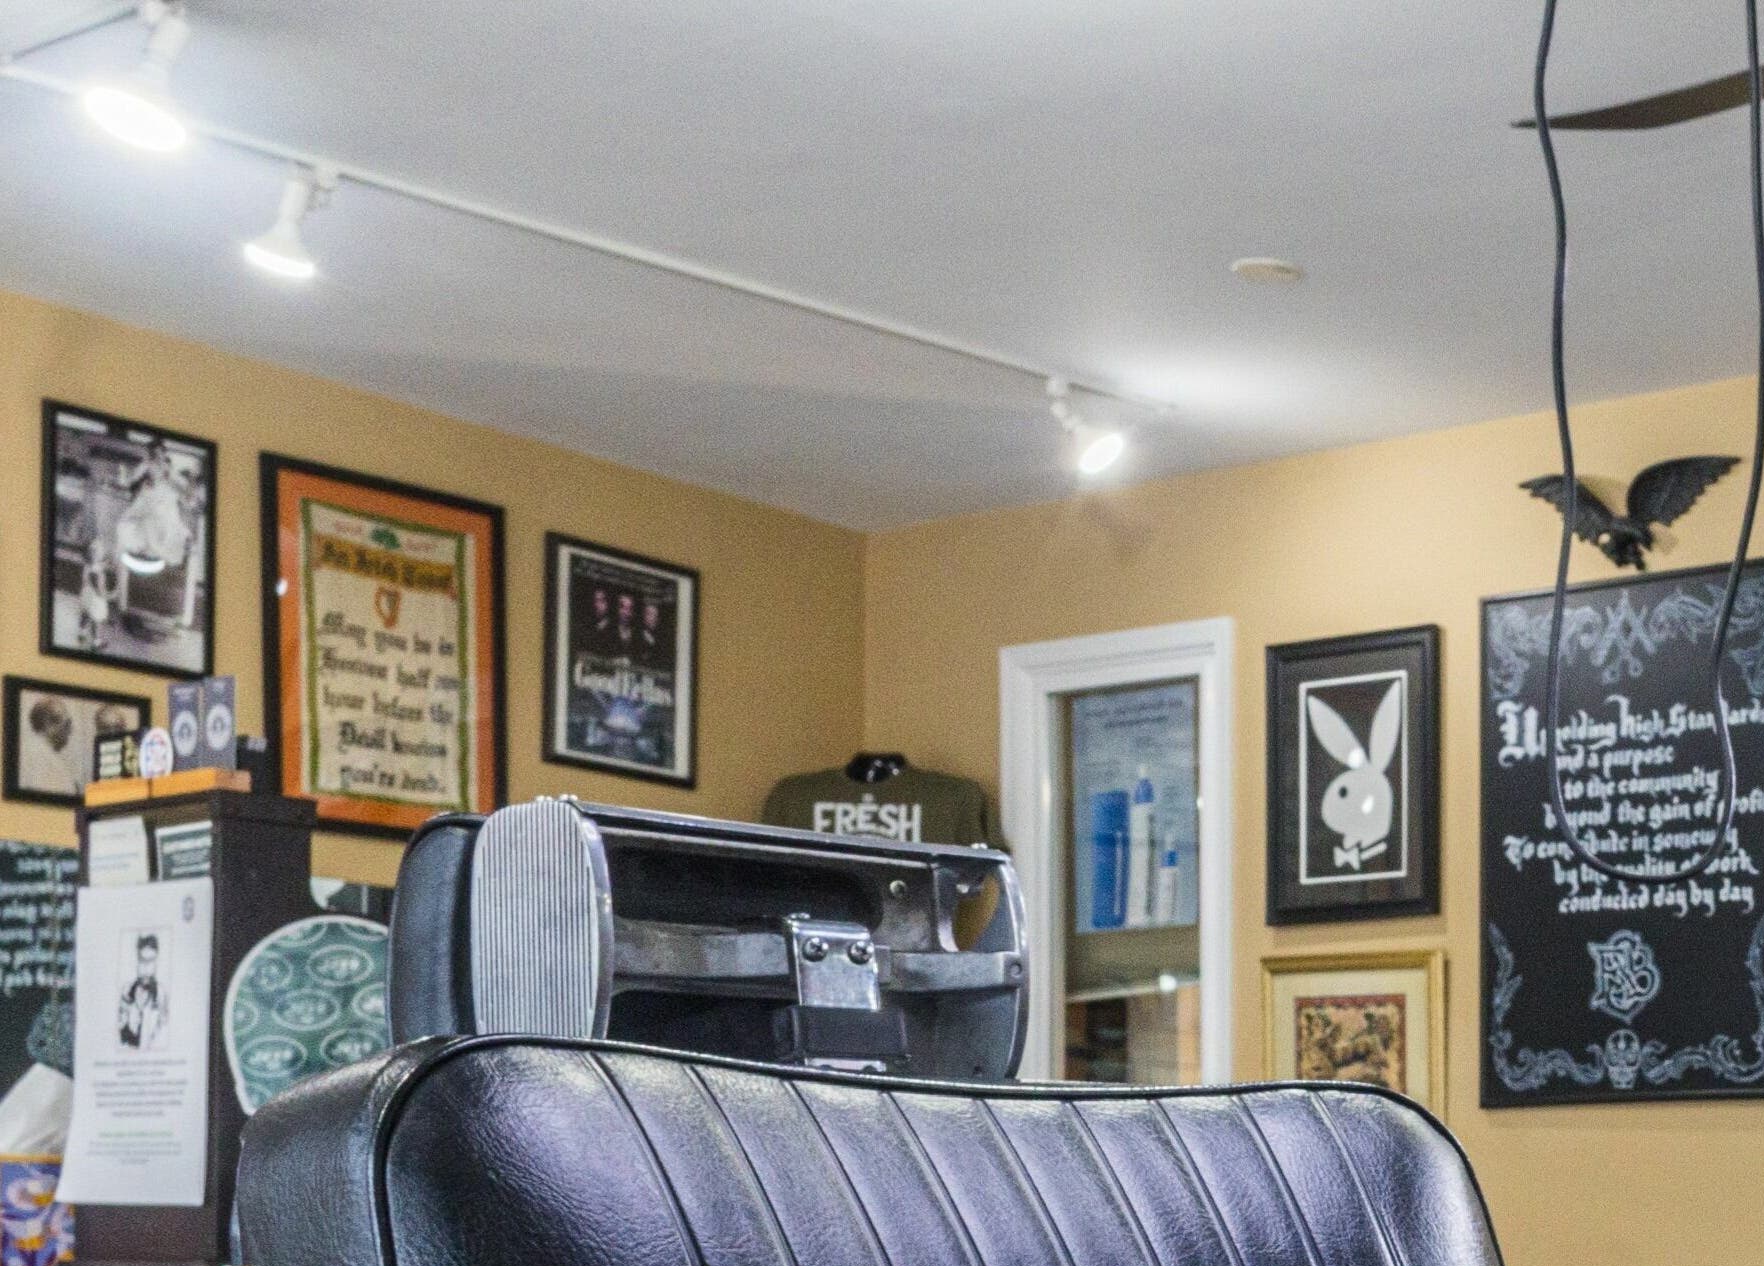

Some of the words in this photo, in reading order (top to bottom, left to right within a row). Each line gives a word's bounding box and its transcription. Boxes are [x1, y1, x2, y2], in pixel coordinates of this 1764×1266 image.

[1555, 744, 1585, 772] nd
[1602, 745, 1675, 779] purpose
[813, 801, 922, 843] FRESH
[1542, 801, 1612, 837] byond
[1648, 796, 1691, 830] gain
[1552, 858, 1580, 896] by
[1558, 879, 1650, 914] conducted
[1652, 882, 1690, 919] day
[1687, 879, 1717, 918] by
[1718, 877, 1756, 915] day
